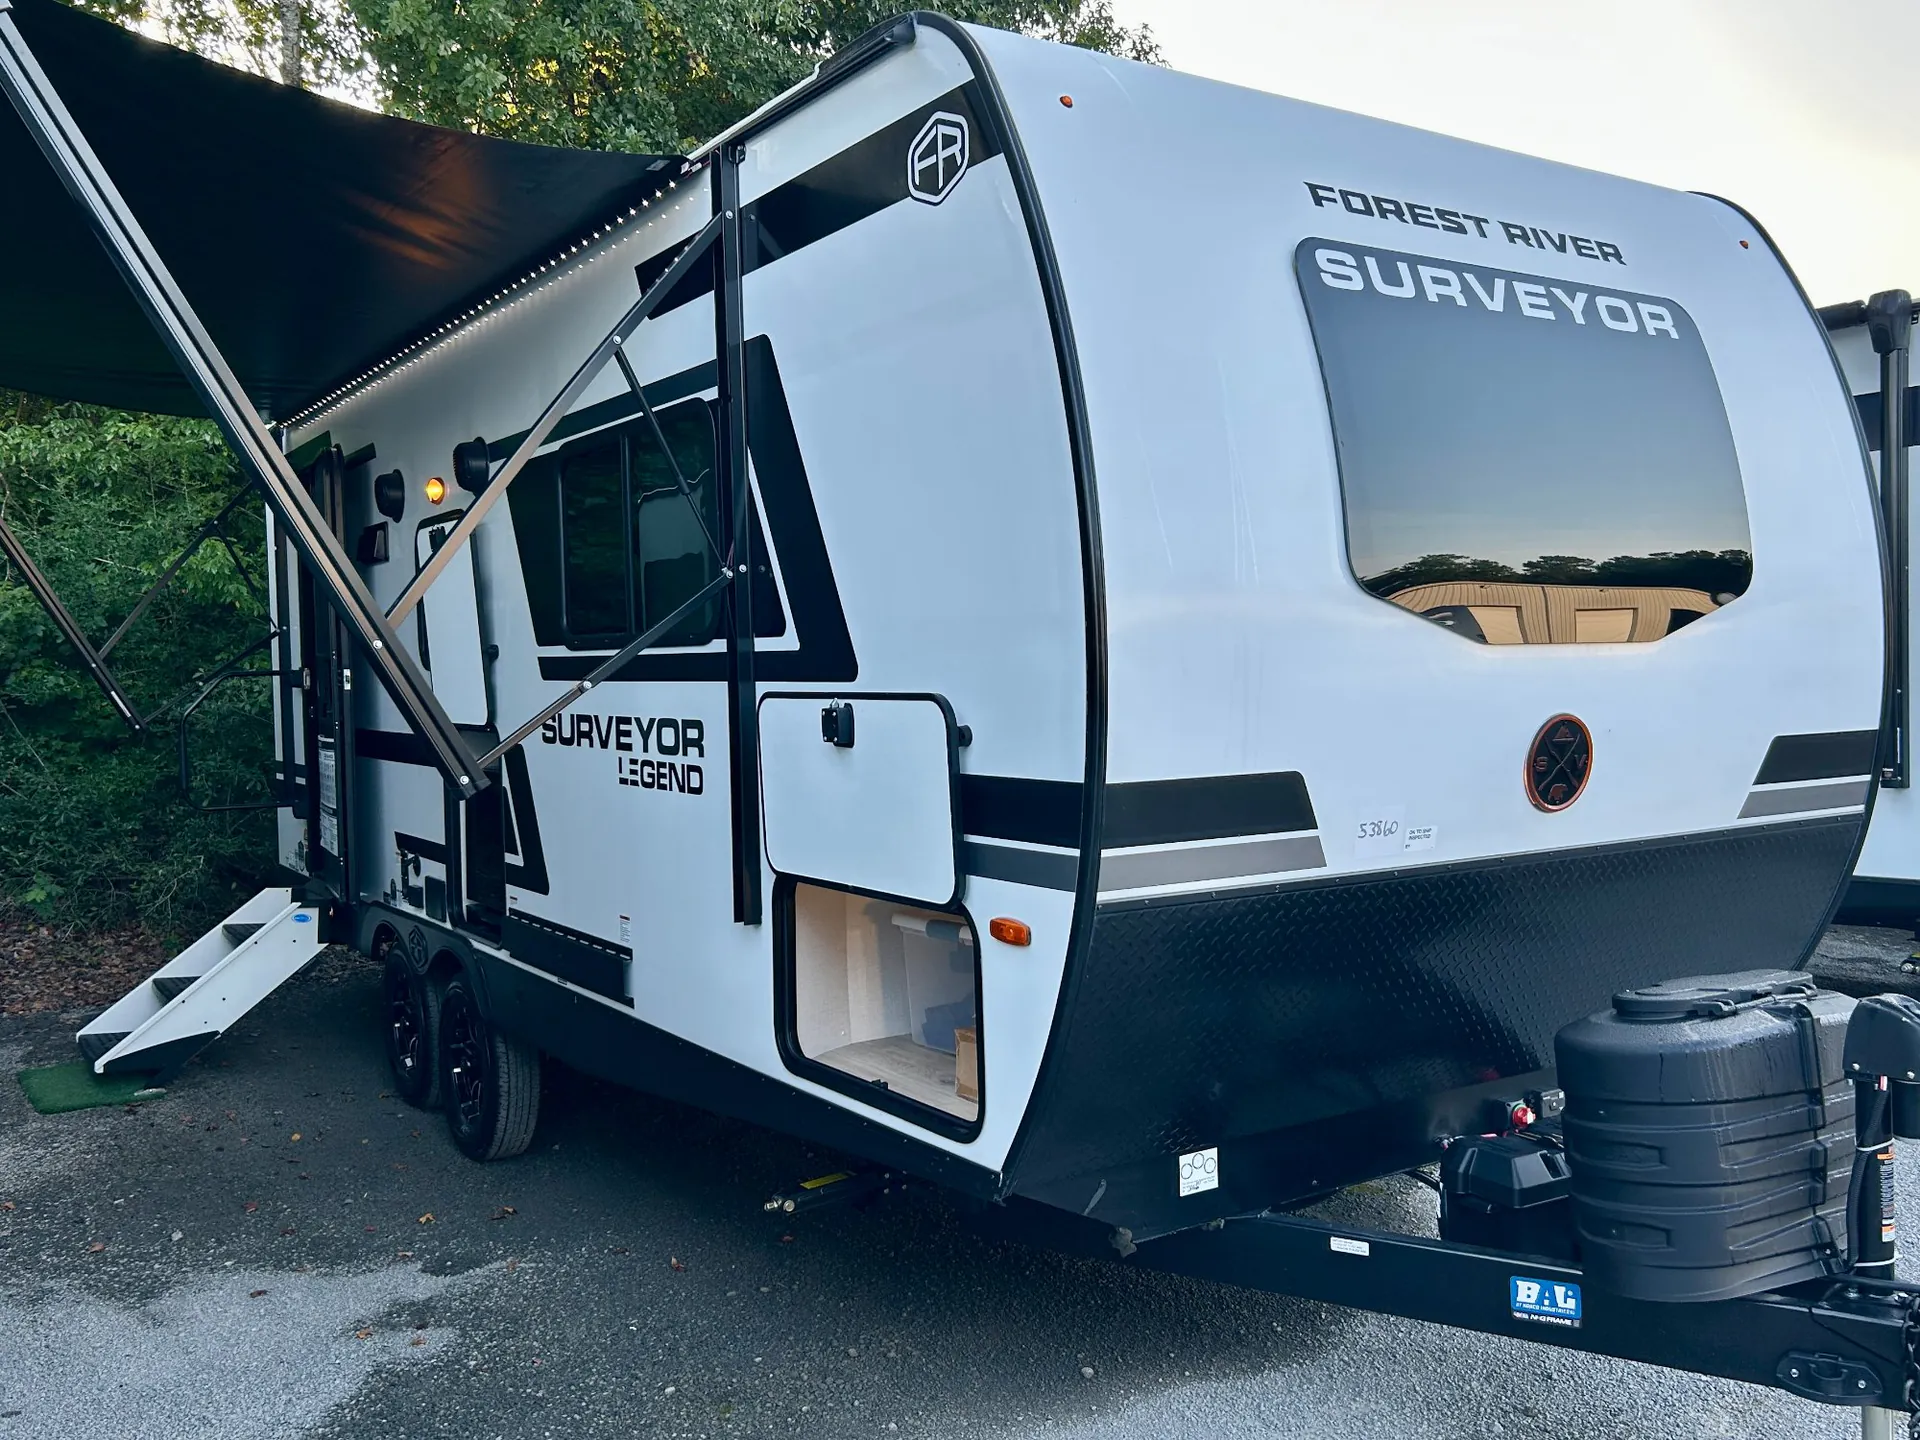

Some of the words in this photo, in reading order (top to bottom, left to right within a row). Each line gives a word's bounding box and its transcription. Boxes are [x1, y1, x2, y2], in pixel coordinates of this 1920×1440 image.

[1303, 181, 1490, 239] FOREST
[1497, 220, 1627, 266] RIVER
[1314, 247, 1680, 340] SURVEYOR
[542, 713, 704, 757] SURVEYOR
[618, 756, 704, 796] LEGEND
[1358, 820, 1398, 838] 53860
[1516, 1280, 1576, 1310] BAL
[1546, 1316, 1573, 1326] FRAME
